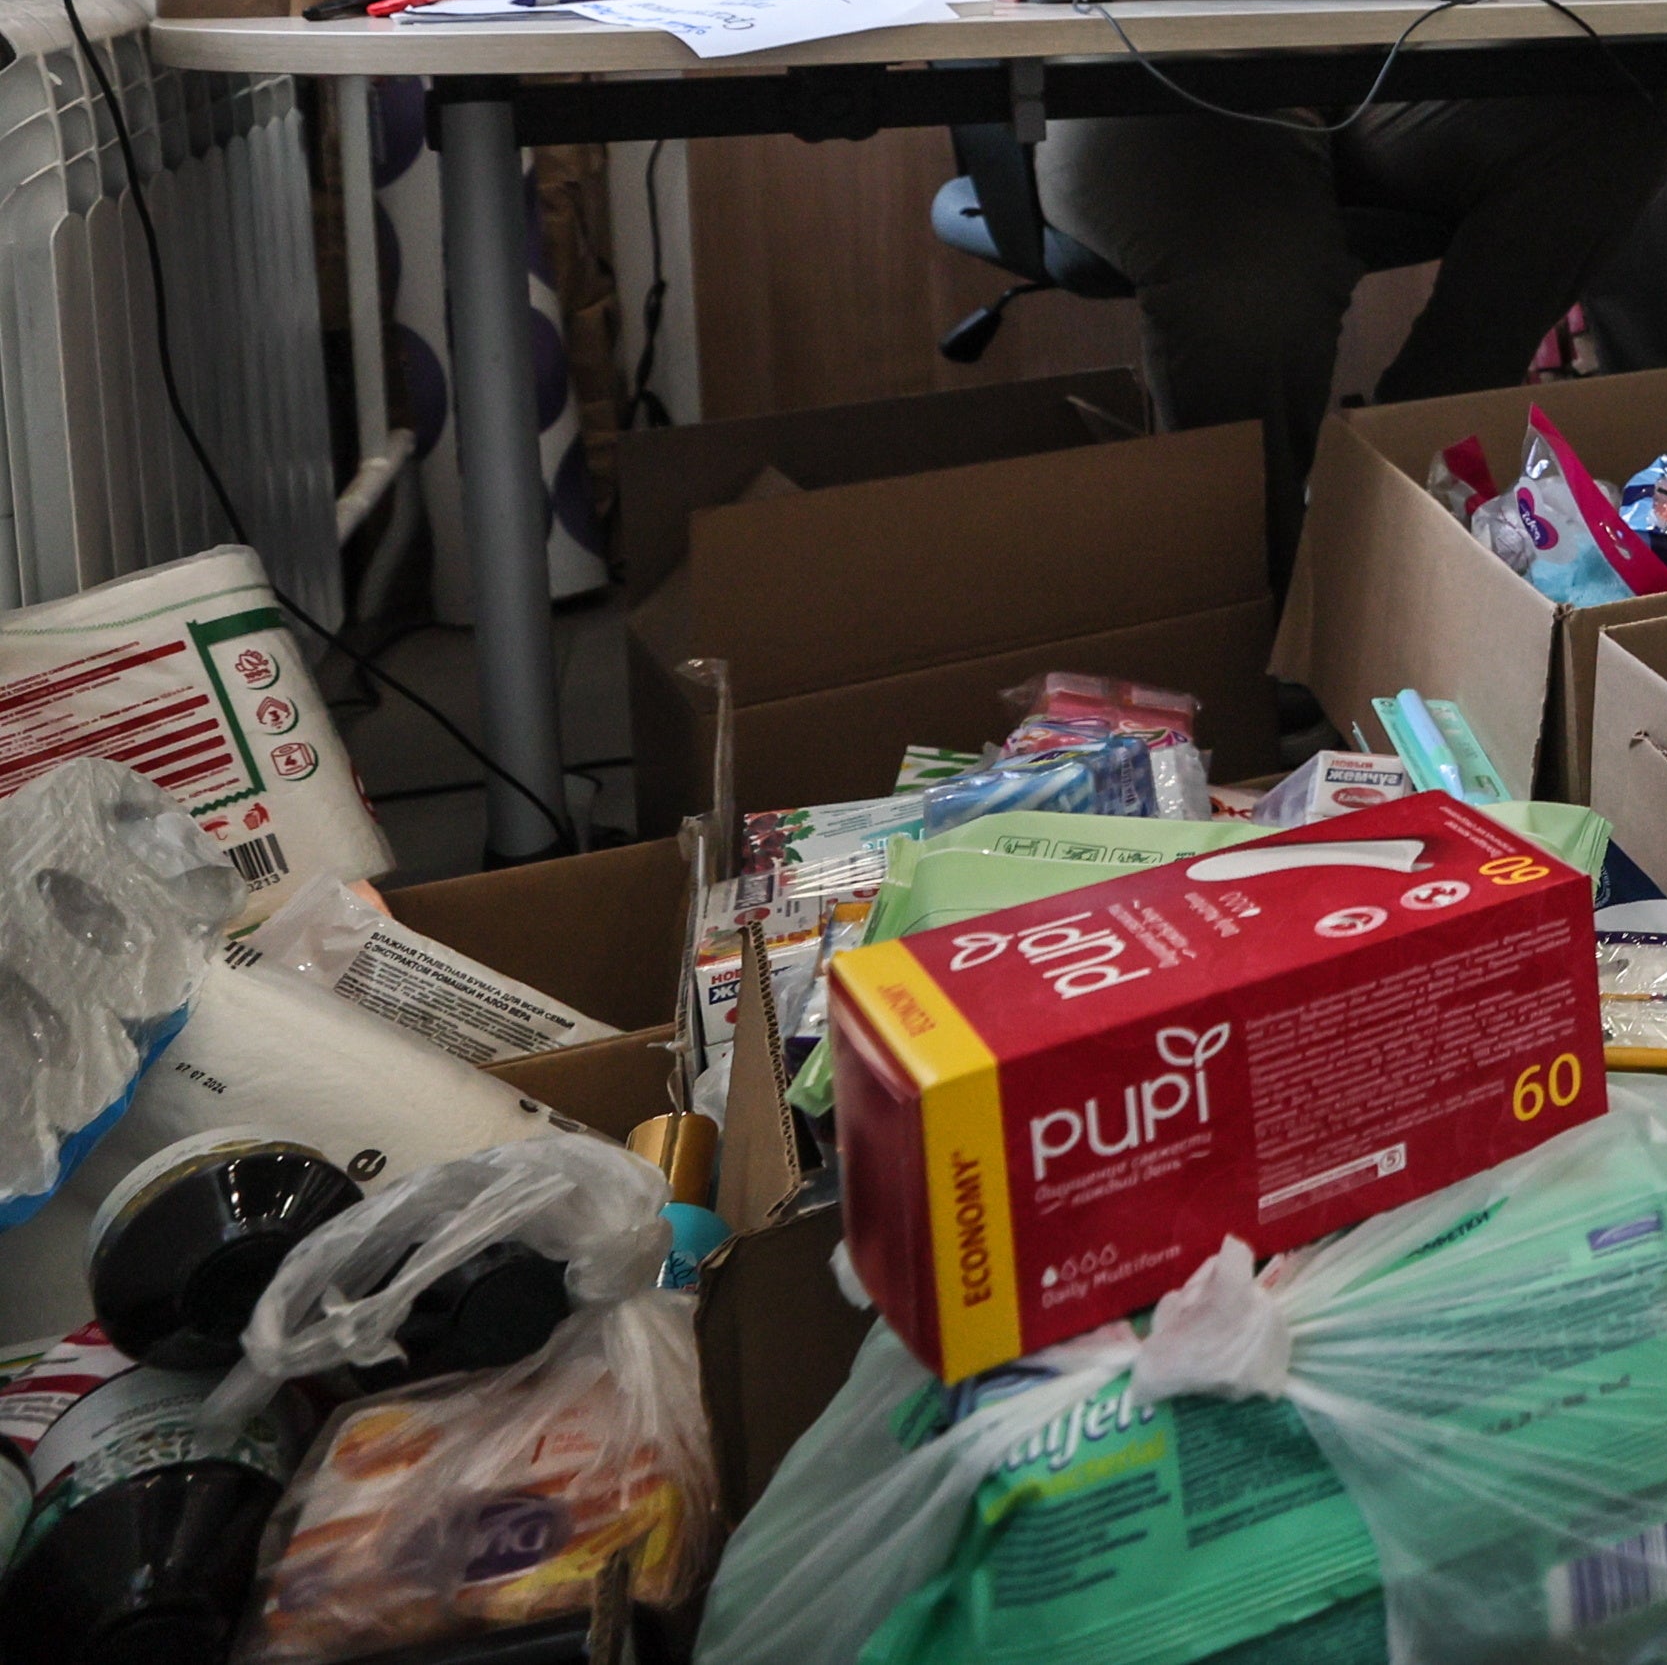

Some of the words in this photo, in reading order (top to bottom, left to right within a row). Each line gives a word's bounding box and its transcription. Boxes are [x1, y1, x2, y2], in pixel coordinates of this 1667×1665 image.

[1478, 855, 1551, 886] 60
[370, 931, 418, 959] ВЛАЖНАЯ
[416, 949, 468, 982] ТУАЛЕТНАЯ
[465, 974, 503, 998] БУМАГА
[500, 990, 522, 1007] ДЛЯ
[520, 999, 546, 1018] ВСЕЙ
[372, 944, 433, 977] ЭКСТРАКТОМ
[431, 971, 477, 998] РОМАШКИ
[482, 994, 509, 1014] АЛОЭ
[507, 1006, 532, 1024] ВЕРА
[1016, 910, 1153, 1001] pupi
[1029, 1070, 1209, 1182] pupi
[1511, 1052, 1582, 1122] 60
